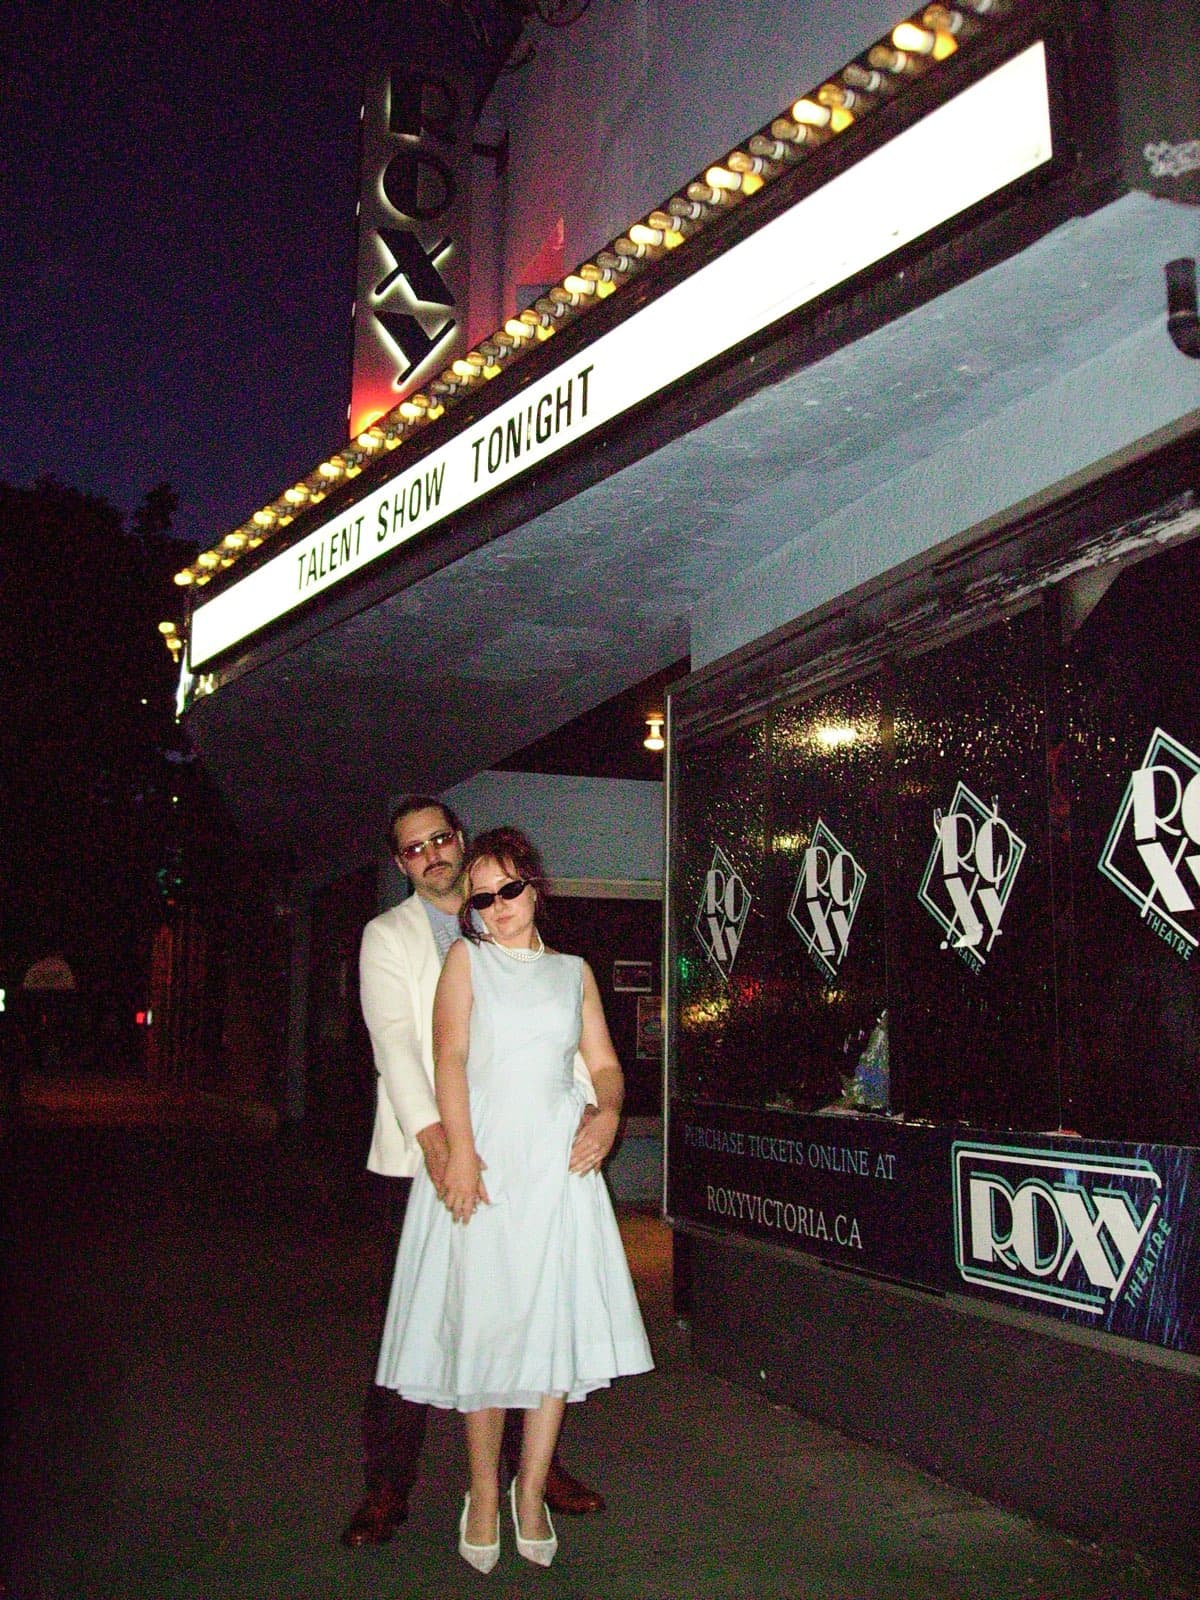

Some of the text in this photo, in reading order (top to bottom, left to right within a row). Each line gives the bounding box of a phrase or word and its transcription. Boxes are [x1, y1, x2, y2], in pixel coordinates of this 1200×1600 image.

[372, 67, 458, 388] ROXY
[298, 364, 594, 590] TALENT SHOW TONIGHT
[951, 933, 982, 976] TEATRE
[1146, 911, 1194, 961] THEATRE
[684, 1124, 896, 1180] PURCHASE TICKETS ONLINE AT
[707, 1185, 863, 1249] ROXYVICTORIA.CA
[969, 1171, 1160, 1302] ROXY
[1124, 1217, 1172, 1308] THEATRE
